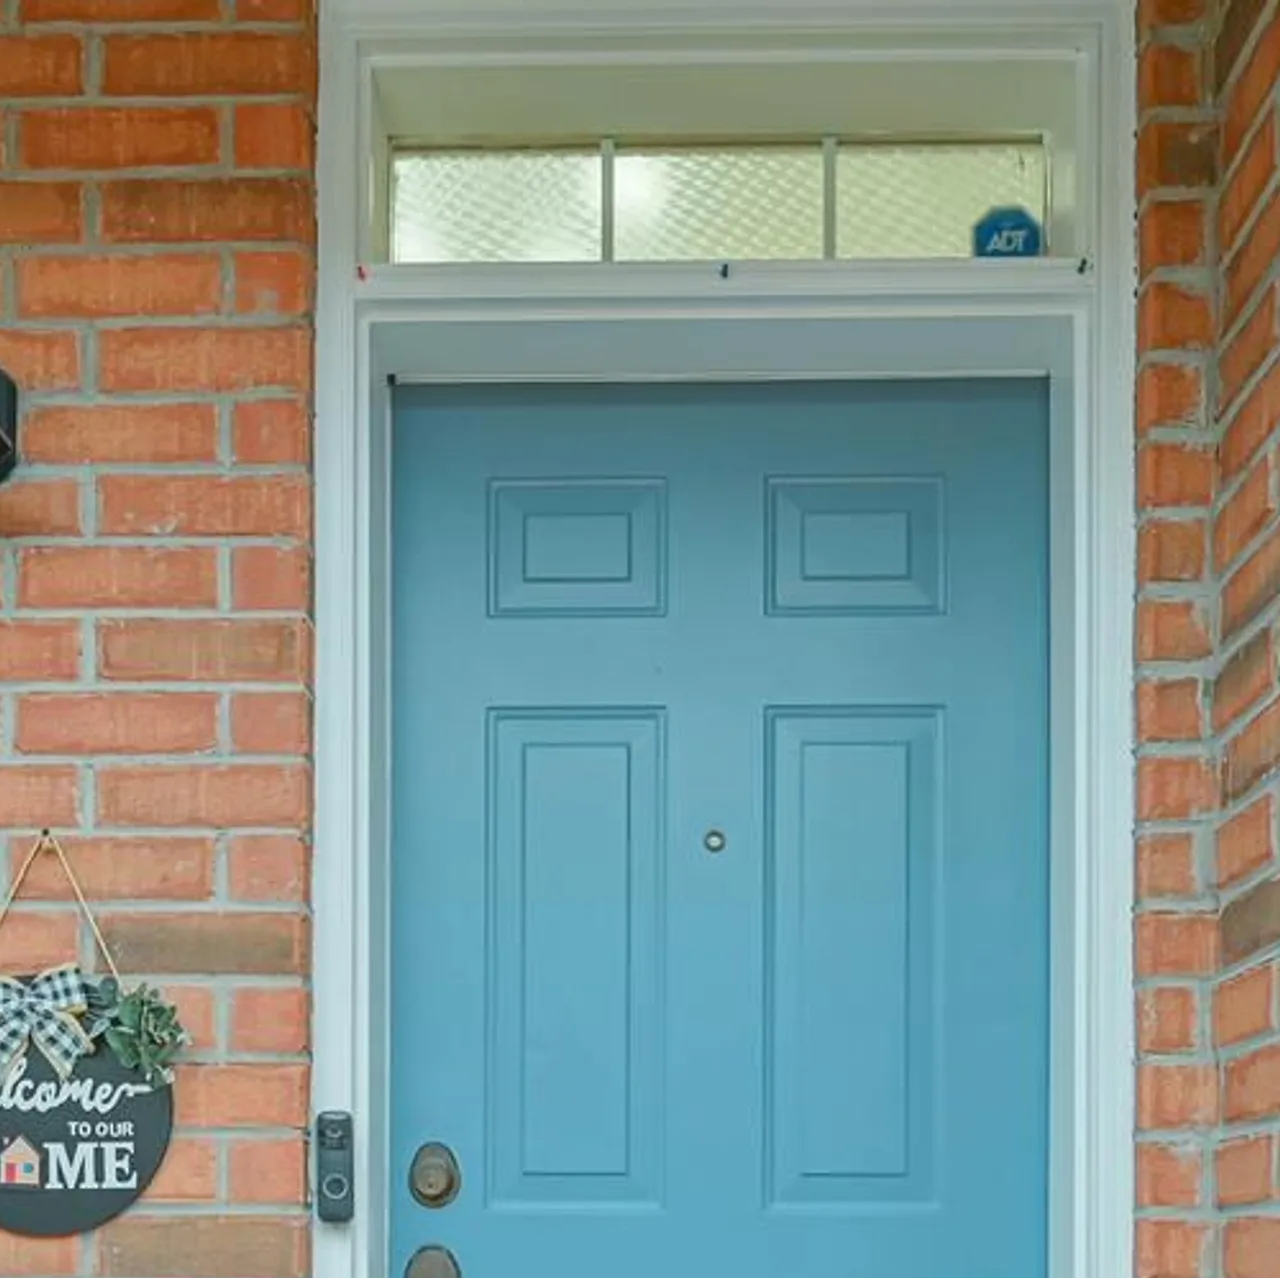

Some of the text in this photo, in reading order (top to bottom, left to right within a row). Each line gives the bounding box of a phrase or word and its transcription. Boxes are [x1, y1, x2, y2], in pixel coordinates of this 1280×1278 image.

[985, 230, 1027, 252] ADT
[69, 1122, 134, 1136] TO OUR
